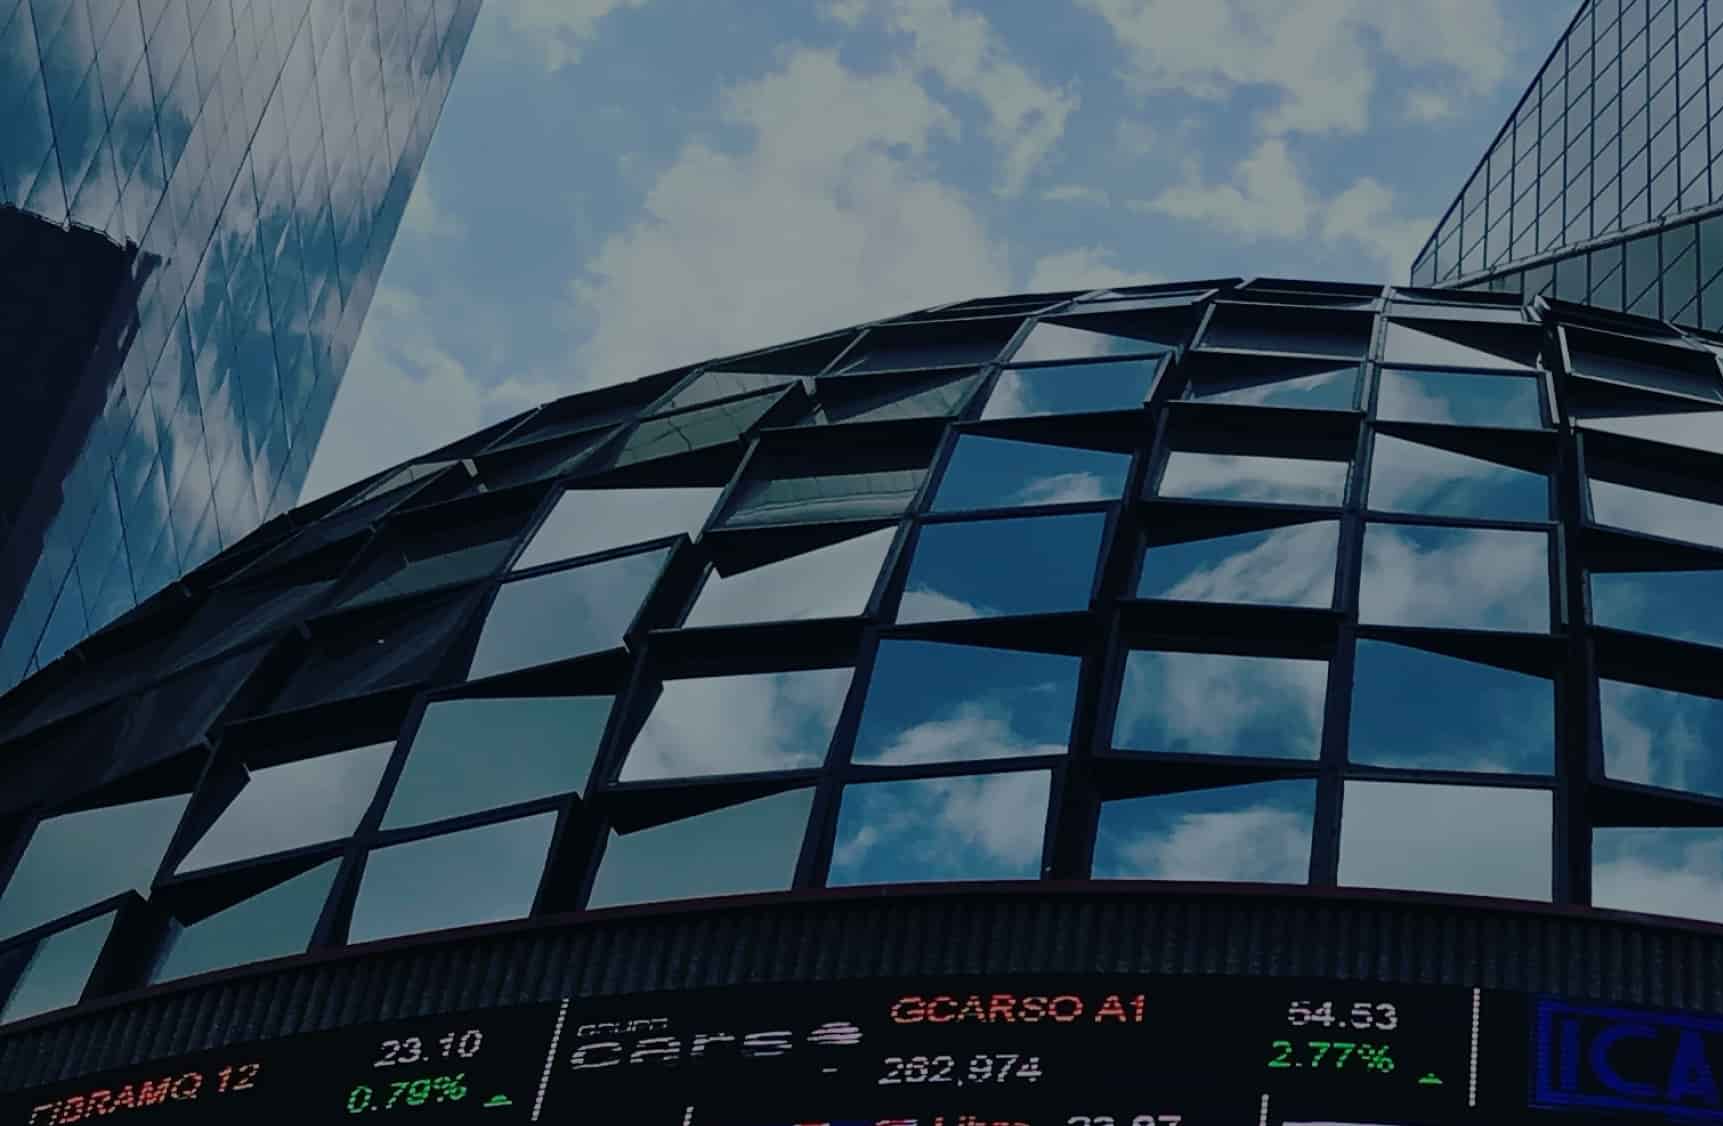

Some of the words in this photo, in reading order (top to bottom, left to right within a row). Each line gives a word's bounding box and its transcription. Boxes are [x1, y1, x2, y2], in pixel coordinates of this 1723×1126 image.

[891, 995, 1083, 1023] GCARSO
[1095, 995, 1144, 1022] A1
[374, 1030, 482, 1067] 23.10
[1268, 1041, 1394, 1072] 2.77%
[1560, 1018, 1720, 1102] ICA
[219, 1064, 259, 1092] 12
[348, 1073, 467, 1113] 0.79%
